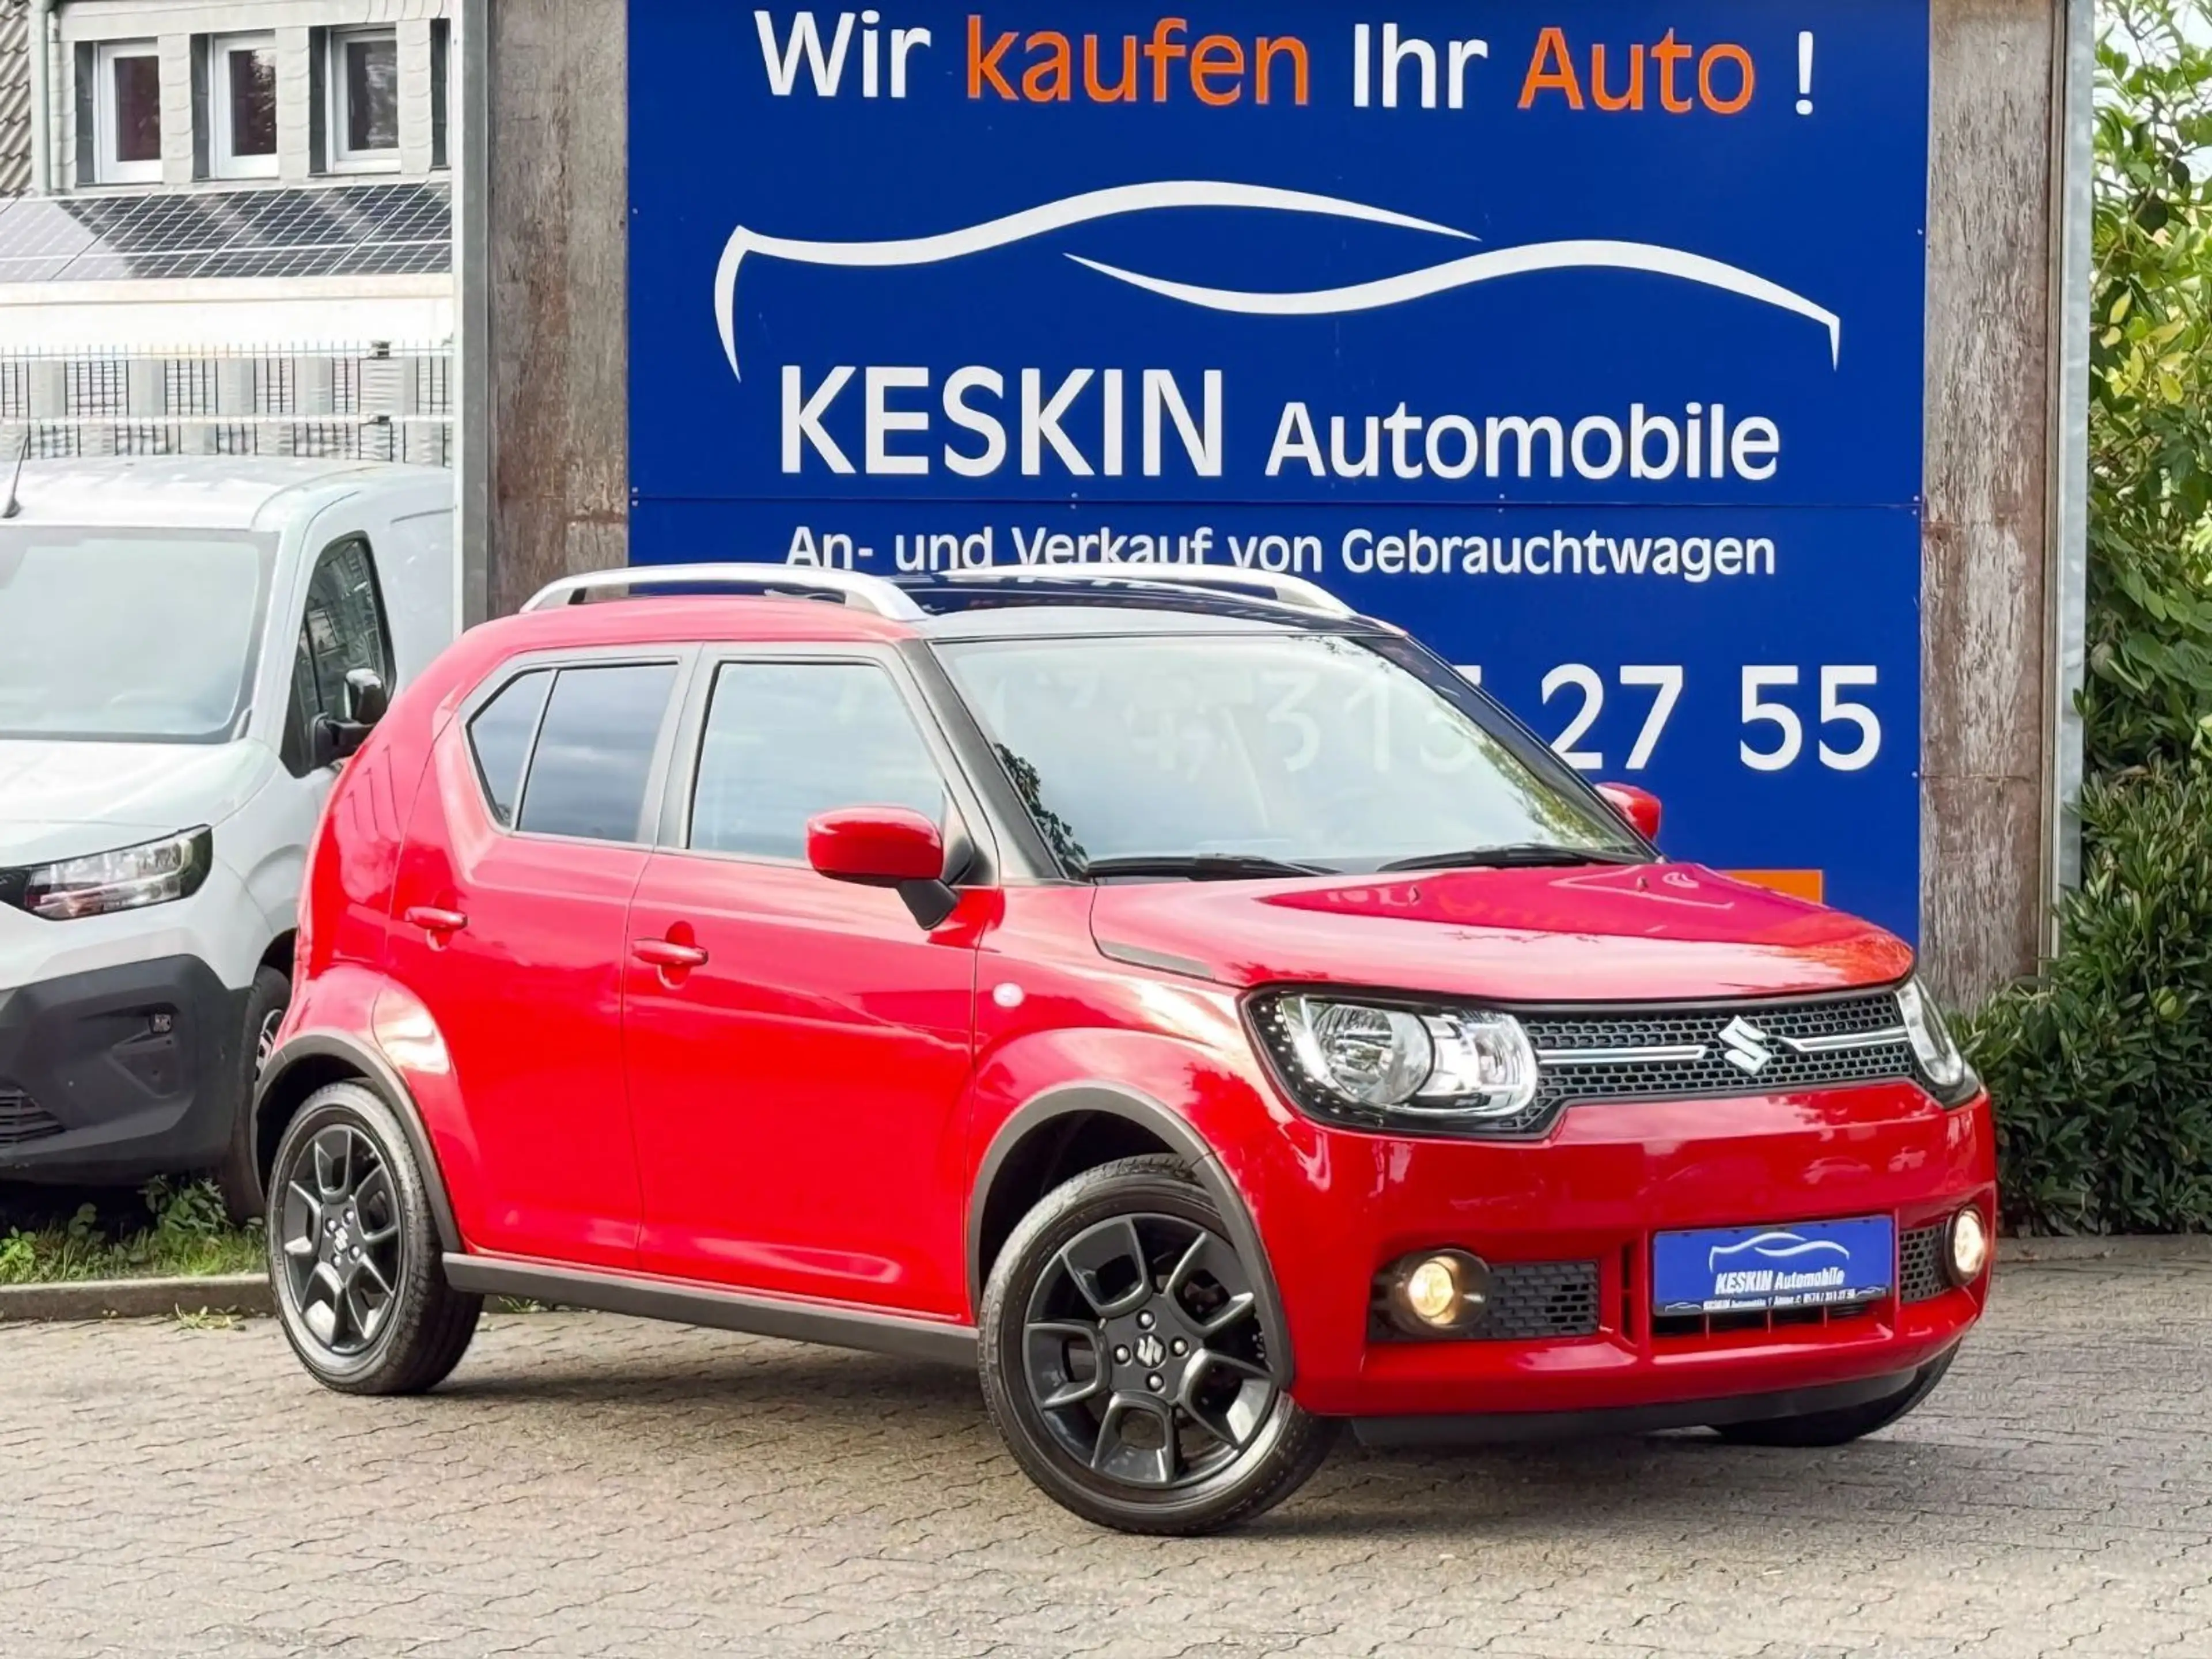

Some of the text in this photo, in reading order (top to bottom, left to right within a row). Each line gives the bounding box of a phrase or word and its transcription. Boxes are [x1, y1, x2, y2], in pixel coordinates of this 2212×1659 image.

[754, 10, 1813, 115] Wir kaufen Ihr Auto !
[782, 365, 1779, 480] KESKIN Automobile
[786, 526, 1775, 583] An- und Verkauf von Gebrauchtwagen
[1541, 663, 1683, 770] 27
[1740, 665, 1881, 771] 55
[1715, 1267, 1845, 1295] KESKIN Automobile
